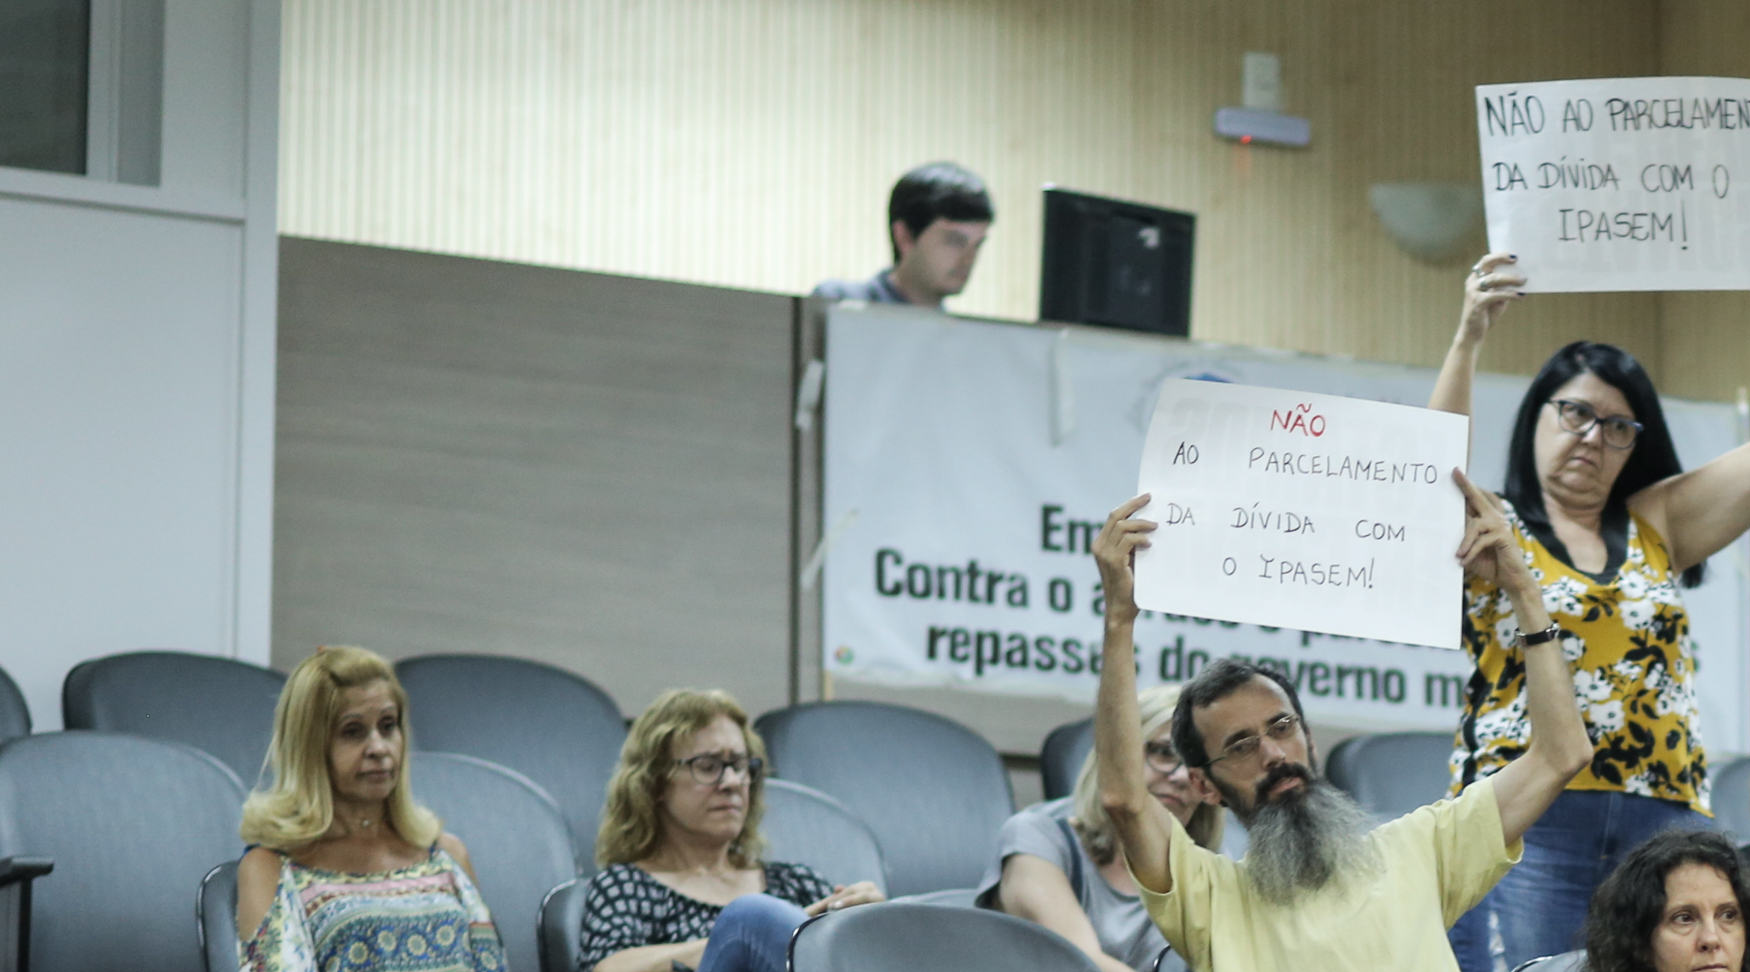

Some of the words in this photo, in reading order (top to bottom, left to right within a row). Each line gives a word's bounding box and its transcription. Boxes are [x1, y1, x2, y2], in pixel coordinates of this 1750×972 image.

[1484, 91, 1545, 136] NÃO
[1562, 98, 1594, 131] AO
[1491, 162, 1528, 191] DA
[1537, 155, 1621, 191] DÍVIDA
[1641, 163, 1694, 192] COM
[1712, 164, 1730, 199] O
[1557, 200, 1689, 250] IPASEM!
[1269, 403, 1326, 437] NÃO
[1172, 441, 1200, 466] AO
[1248, 446, 1438, 485] PARCELAMENTO
[1166, 502, 1196, 527] DA
[1230, 502, 1315, 534] DÍVIDA
[1355, 519, 1406, 542] COM
[874, 547, 1030, 609] Contra
[1048, 576, 1074, 613] o
[1222, 557, 1237, 577] O
[1258, 554, 1375, 589] IPASEM!
[926, 624, 1142, 678] repass
